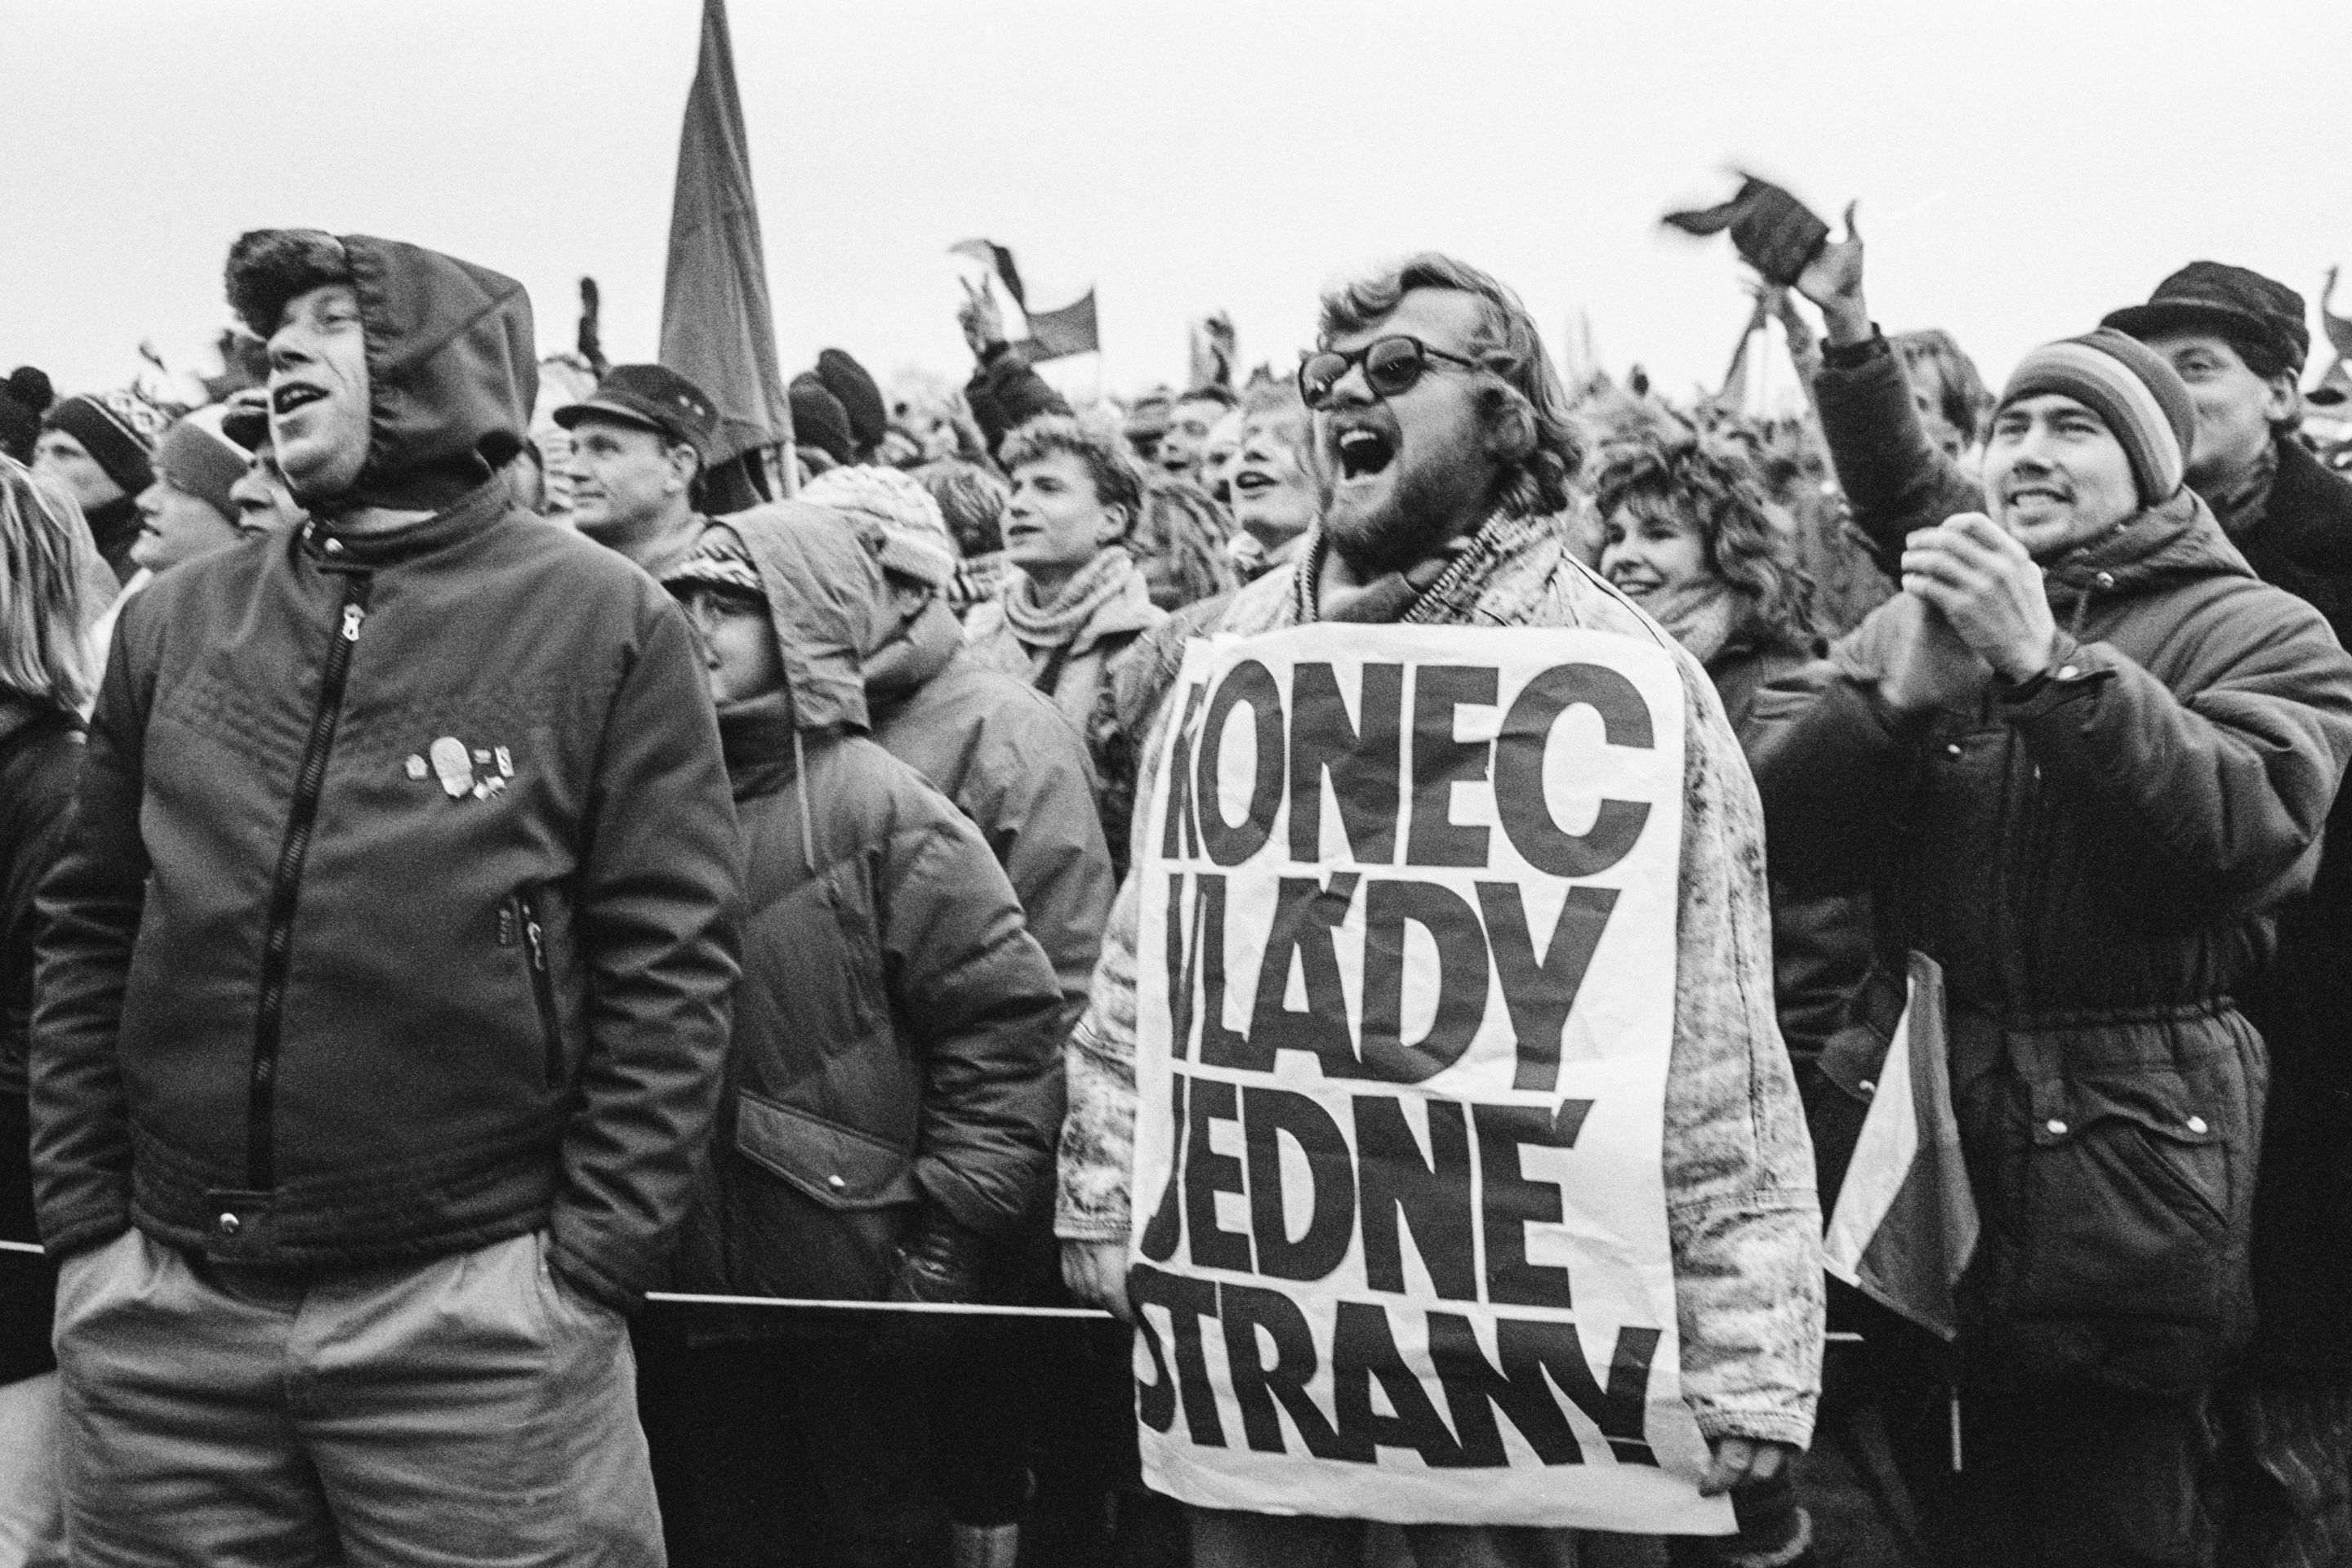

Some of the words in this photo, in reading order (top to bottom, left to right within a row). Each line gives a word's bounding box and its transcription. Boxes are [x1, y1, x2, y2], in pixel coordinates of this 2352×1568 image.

[1166, 871, 1622, 1093] VLÁDY
[1140, 1071, 1596, 1310] JEDNÉ
[1126, 1263, 1661, 1468] STRANY
